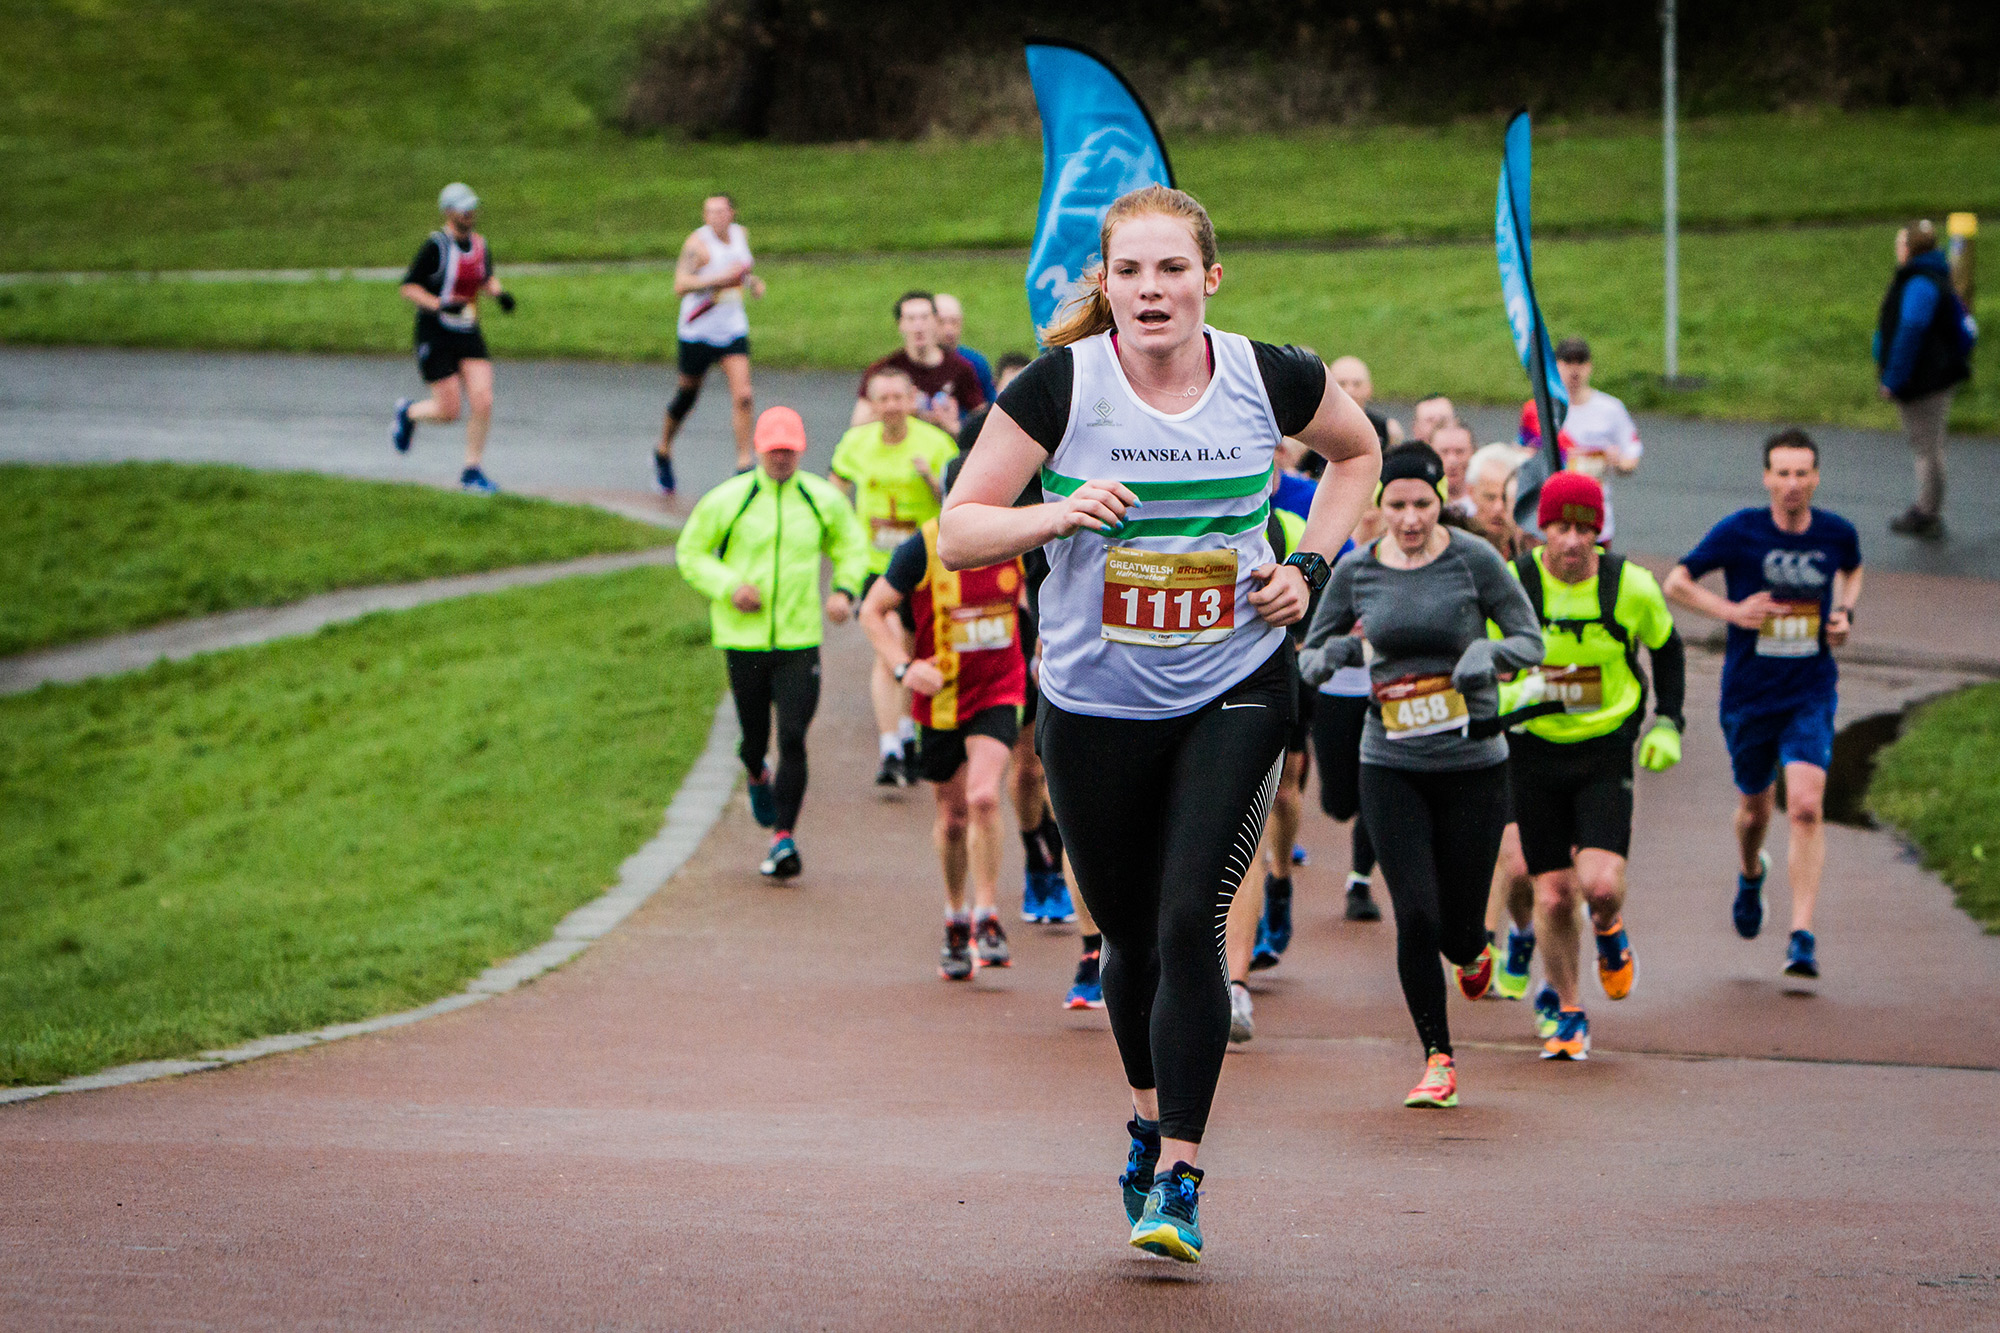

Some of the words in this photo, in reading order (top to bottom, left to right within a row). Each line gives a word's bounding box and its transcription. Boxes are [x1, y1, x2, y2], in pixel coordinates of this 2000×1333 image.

[1110, 448, 1192, 462] SWANSEA
[1197, 446, 1241, 461] H.A.C
[1177, 564, 1235, 575] #RunCymru
[1120, 587, 1221, 628] 1113
[1397, 694, 1449, 727] 458
